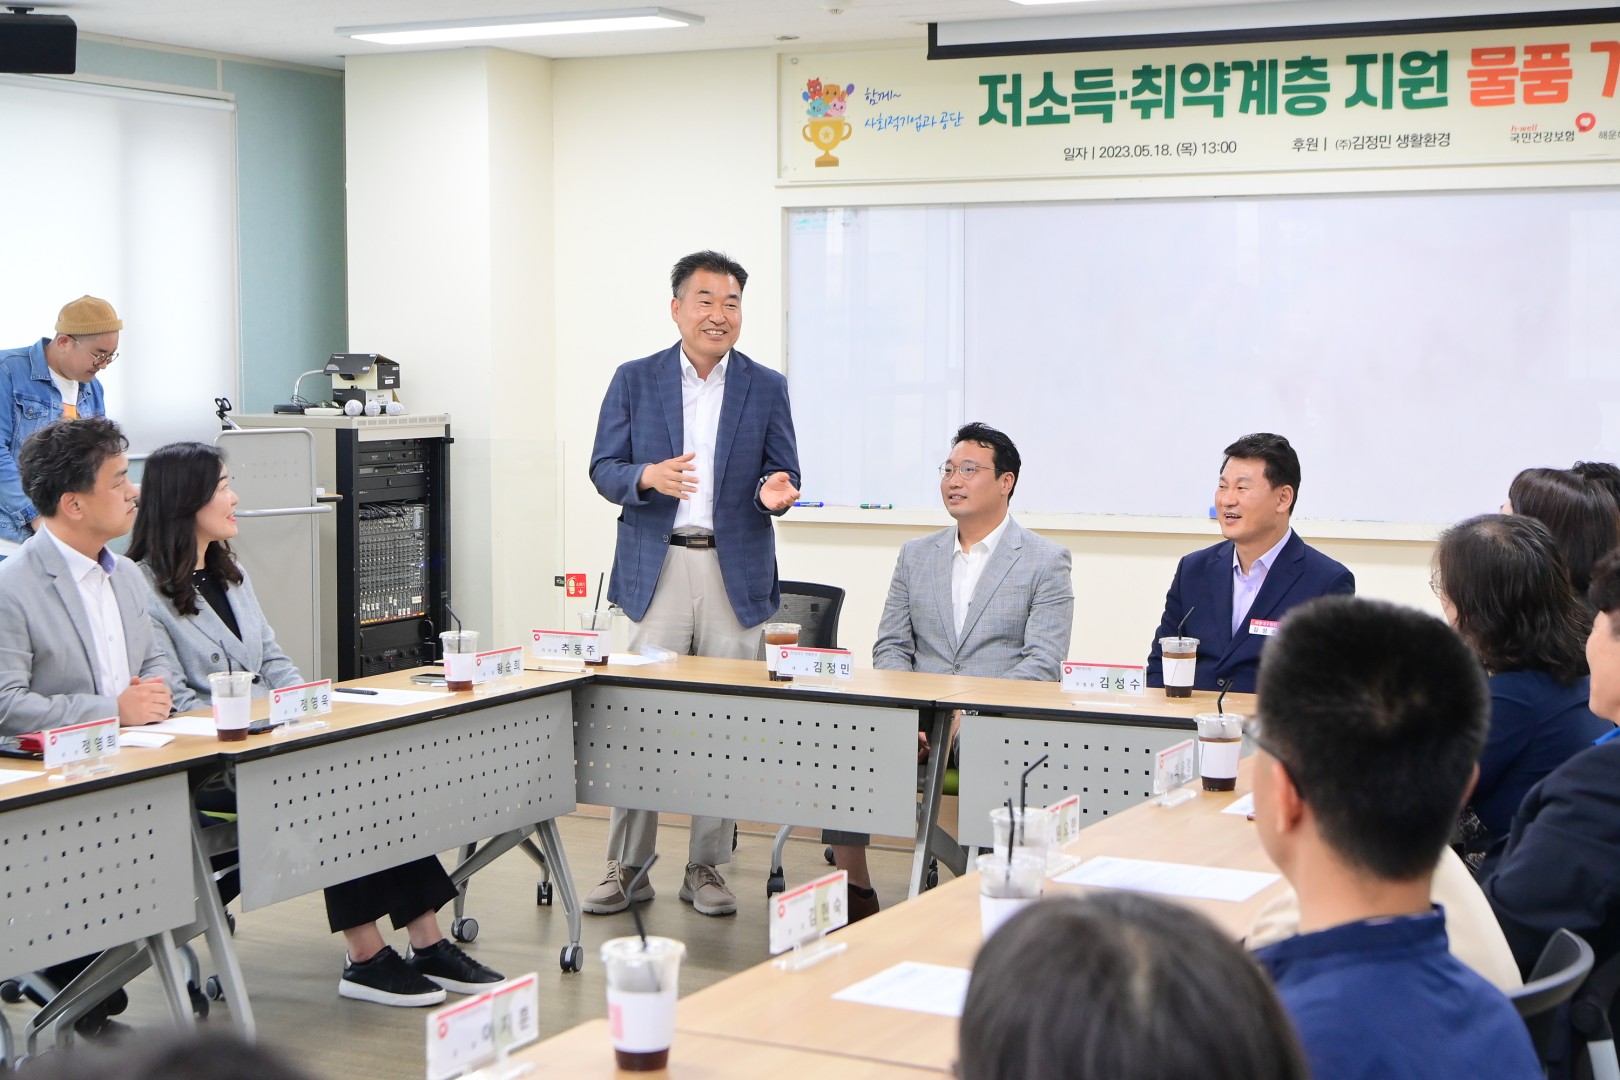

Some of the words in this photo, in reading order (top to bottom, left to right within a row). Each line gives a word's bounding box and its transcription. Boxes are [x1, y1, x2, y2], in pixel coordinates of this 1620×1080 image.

[978, 56, 1331, 127] 저소득·취약계층
[1344, 49, 1449, 110] 지원
[1467, 42, 1574, 107] 물품
[864, 113, 937, 133] 사회적기업과
[939, 110, 965, 130] 공단
[1291, 136, 1319, 152] 후원
[1335, 134, 1392, 150] (주)김정민
[1395, 131, 1451, 148] 생활환경
[1510, 130, 1575, 144] 국민건강보험
[1063, 147, 1088, 161] 일자
[1098, 144, 1173, 159] 2023.05.18.
[1175, 141, 1198, 157] (목)
[1201, 140, 1238, 155] 13:00
[814, 661, 850, 674] 김정민
[1099, 676, 1141, 691] 김성수
